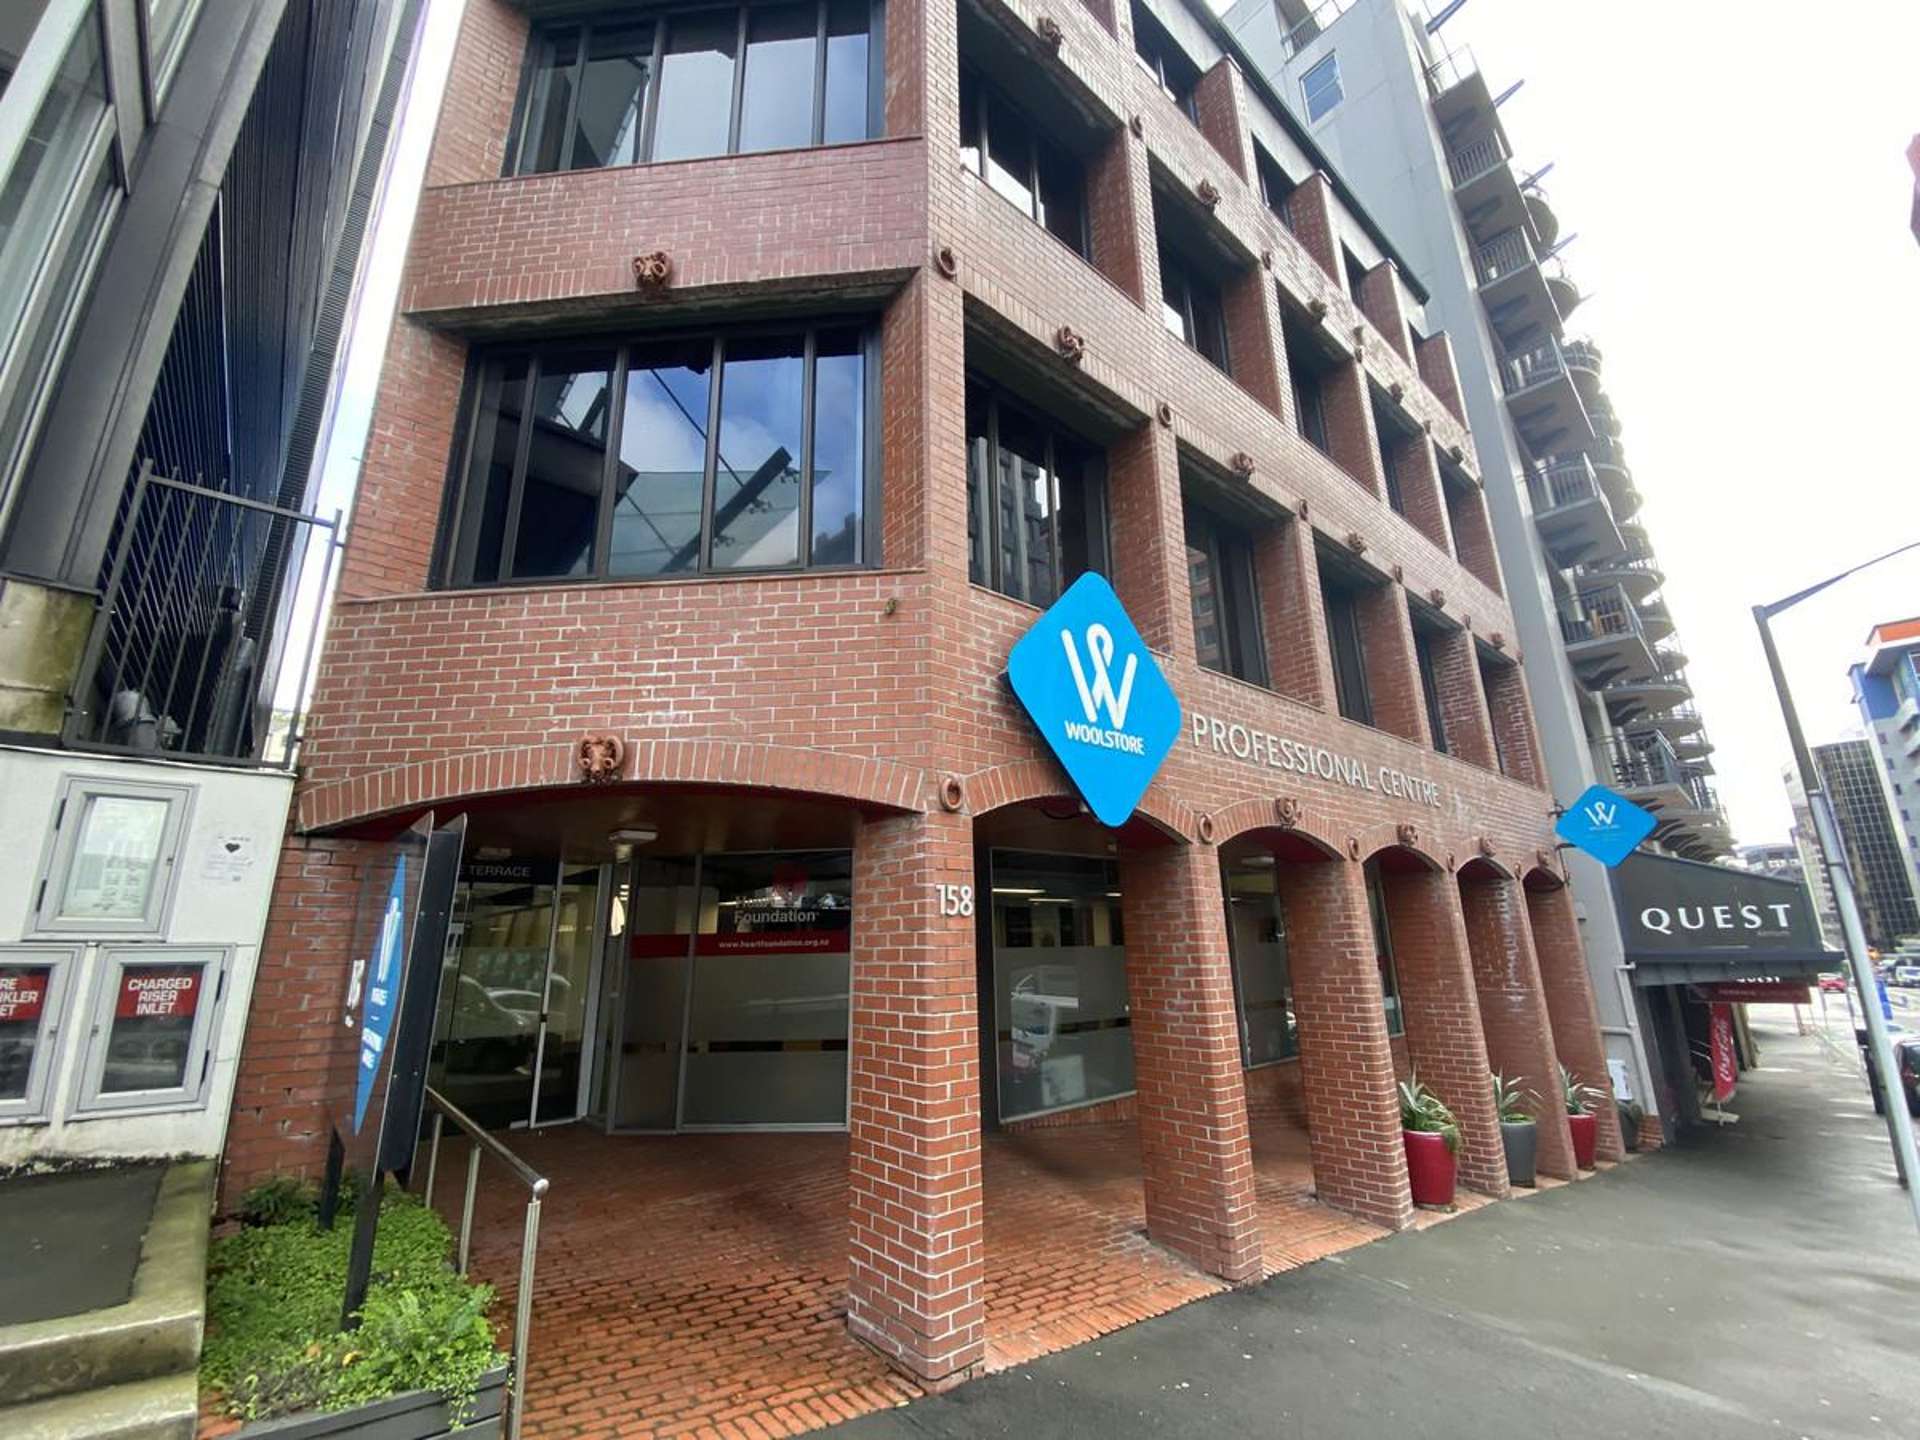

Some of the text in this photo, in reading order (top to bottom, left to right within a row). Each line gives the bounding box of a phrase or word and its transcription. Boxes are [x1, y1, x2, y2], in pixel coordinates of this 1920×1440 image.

[1063, 719, 1146, 756] WOOLSTORE
[1190, 712, 1442, 807] PROFESSIONAL CENTRE
[469, 864, 532, 878] TERRACE
[935, 883, 974, 916] 158
[734, 908, 817, 924] Foundation
[1640, 903, 1791, 936] QUEST
[127, 977, 193, 991] CHARGED
[138, 990, 178, 1003] RISER
[136, 1002, 176, 1016] INLET
